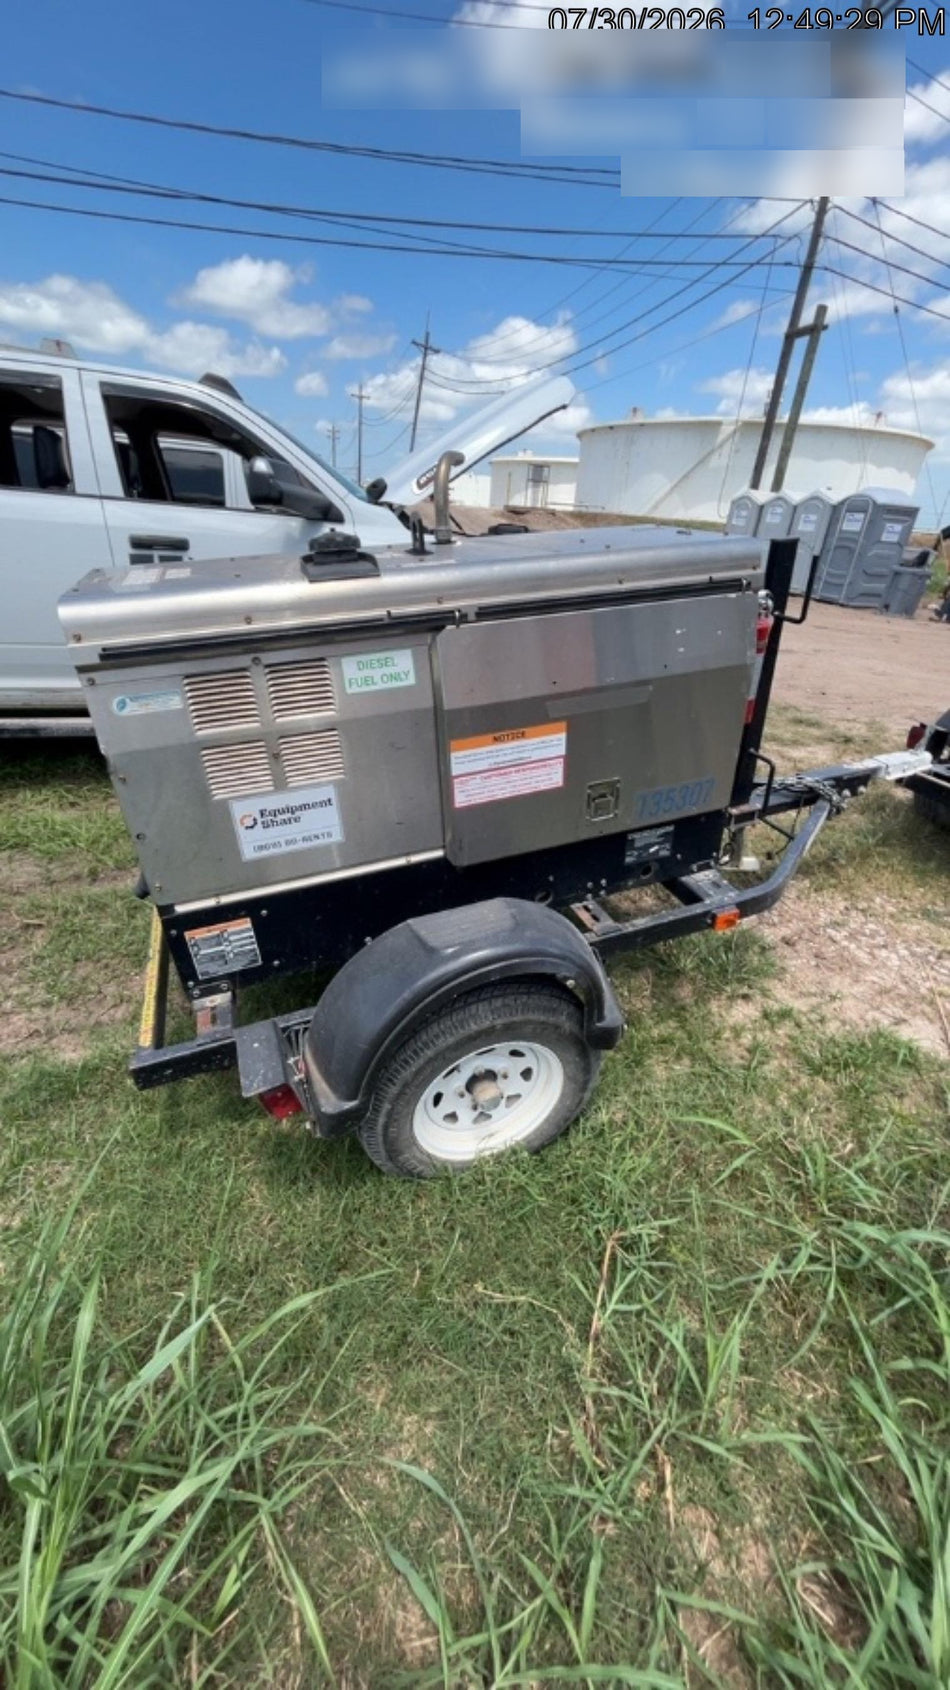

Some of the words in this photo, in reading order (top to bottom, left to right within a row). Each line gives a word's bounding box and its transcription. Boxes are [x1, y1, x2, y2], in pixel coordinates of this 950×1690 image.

[357, 657, 398, 671] DIESEL
[348, 675, 377, 689] FUEL
[381, 670, 410, 684] ONLY
[492, 730, 526, 743] NOTICE
[259, 797, 333, 819] Equipment
[261, 815, 301, 829] Share
